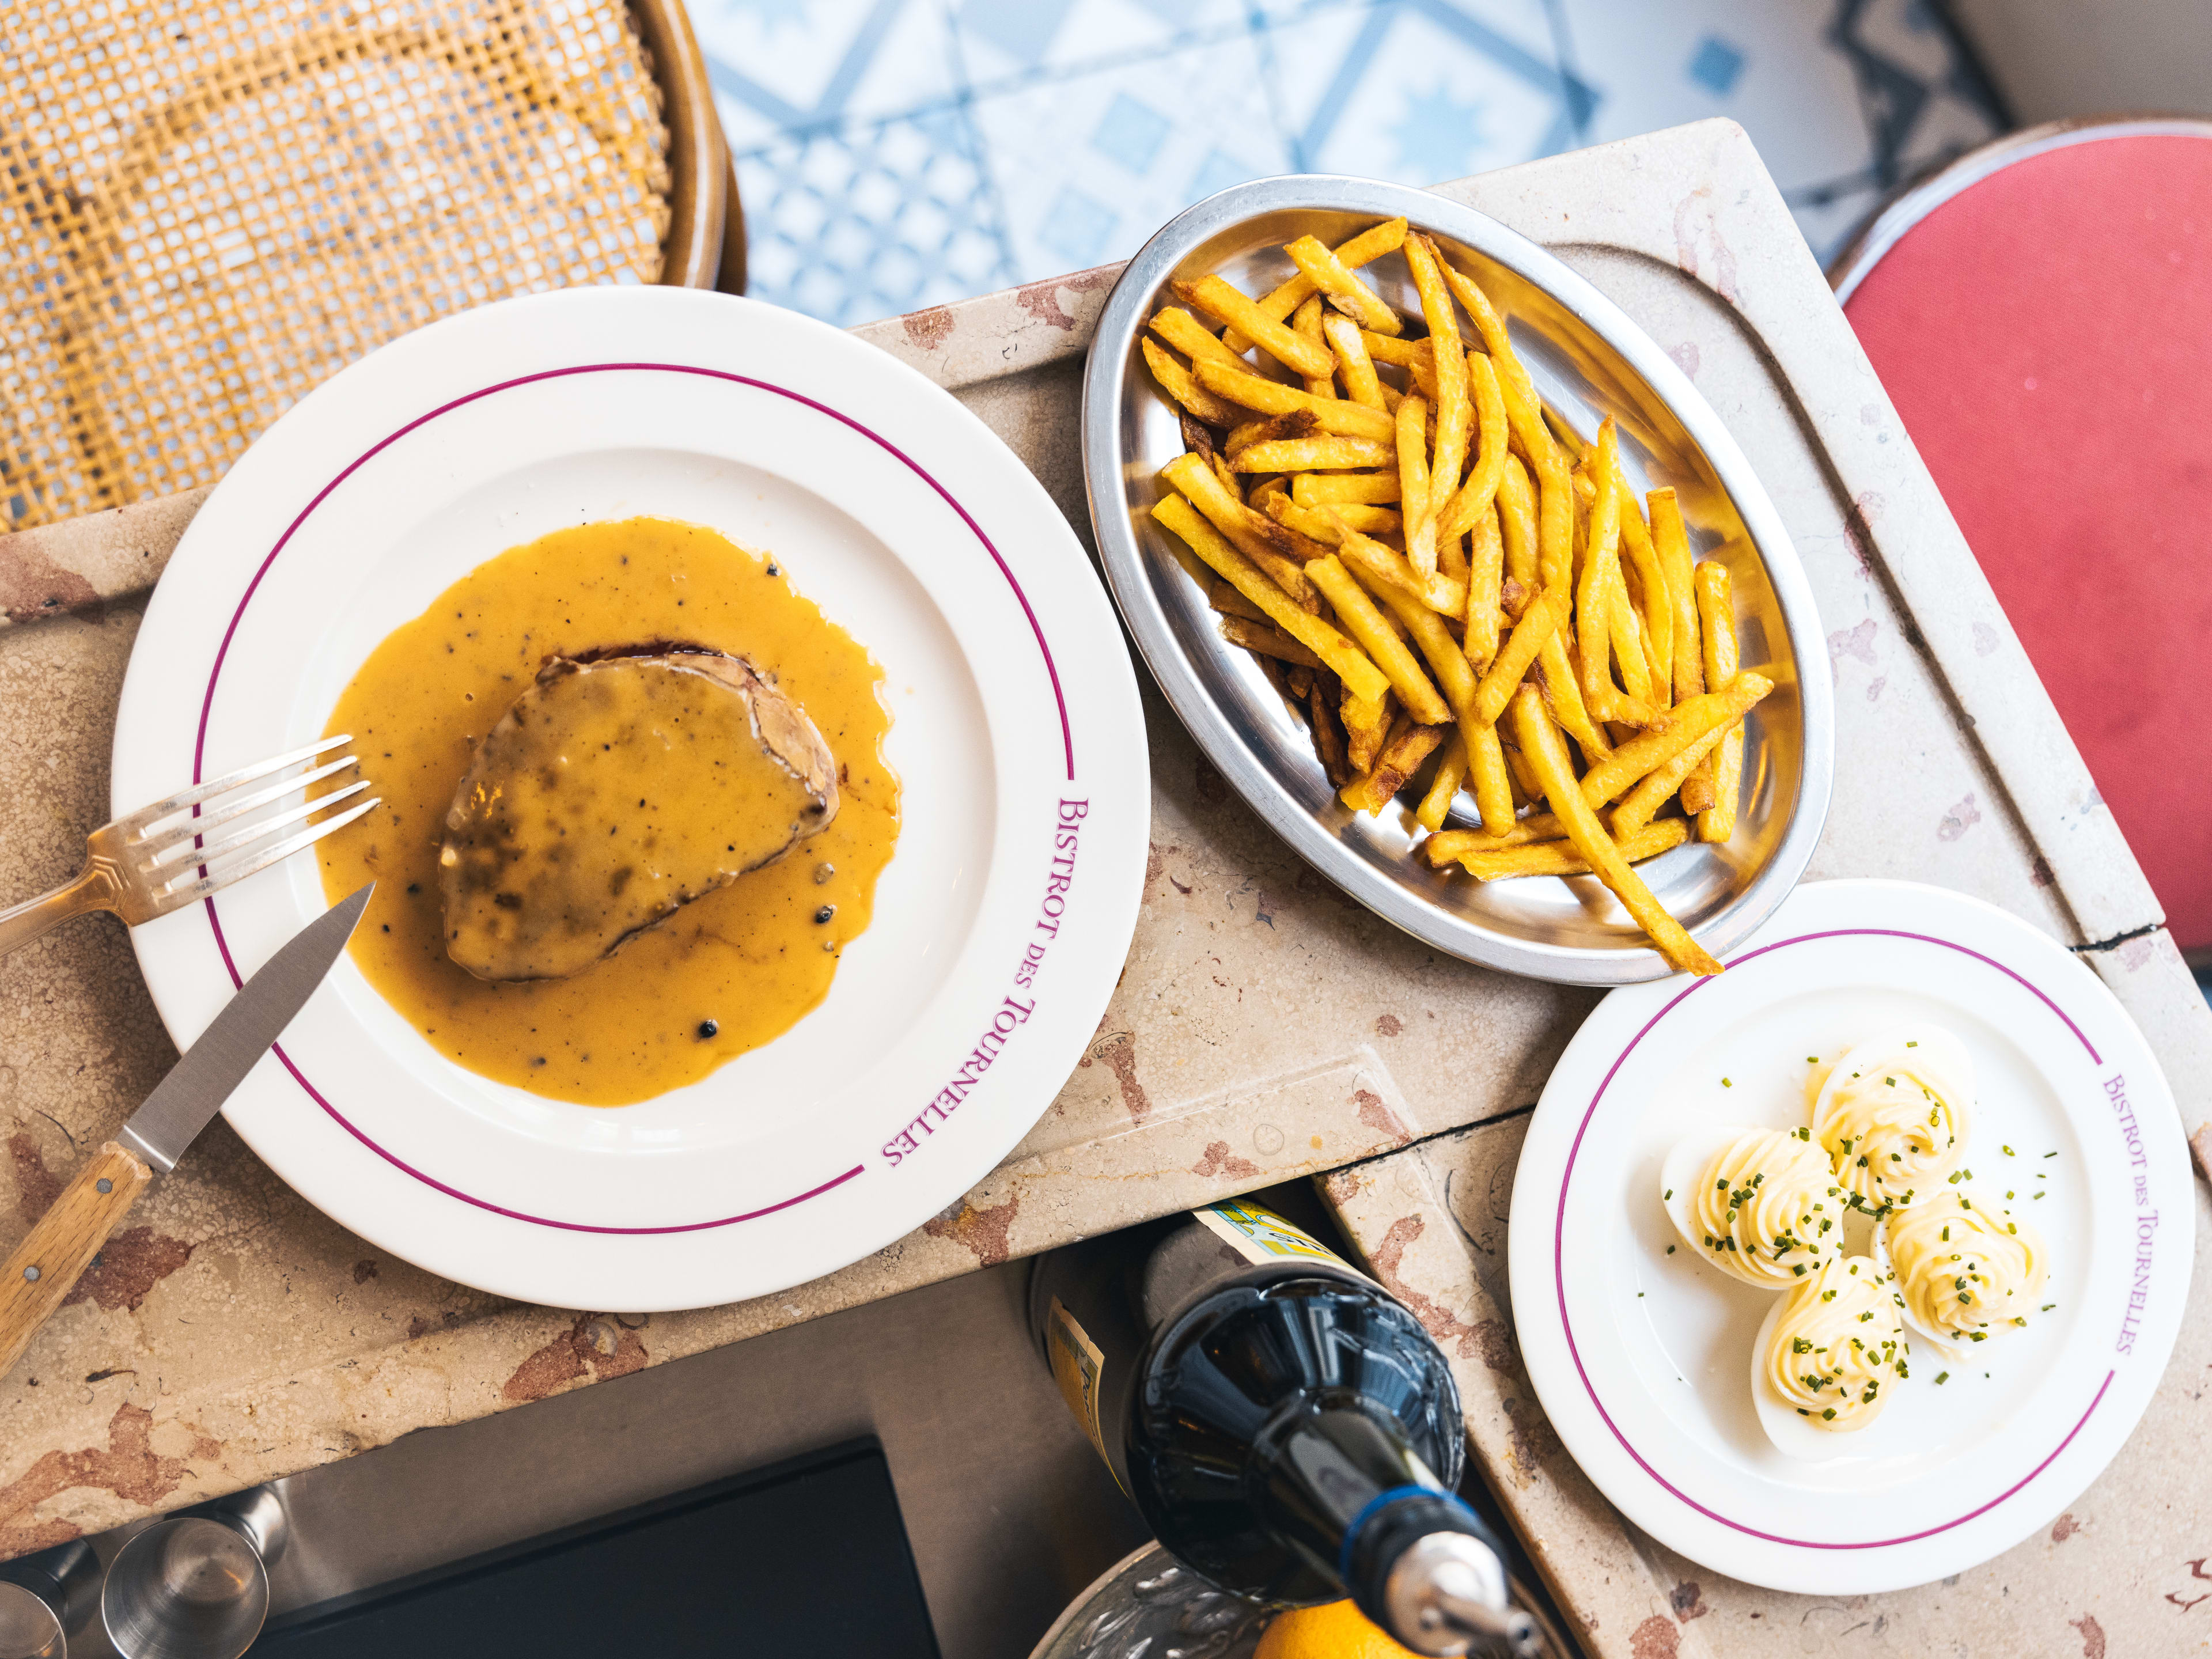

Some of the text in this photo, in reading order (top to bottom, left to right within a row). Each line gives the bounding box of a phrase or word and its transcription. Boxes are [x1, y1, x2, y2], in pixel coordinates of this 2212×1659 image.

[1036, 796, 1090, 940] BISTROT
[881, 995, 1037, 1169] TOURNELLES
[2103, 1073, 2149, 1169] BISTROT
[2116, 1209, 2159, 1356] TOURNELLES
